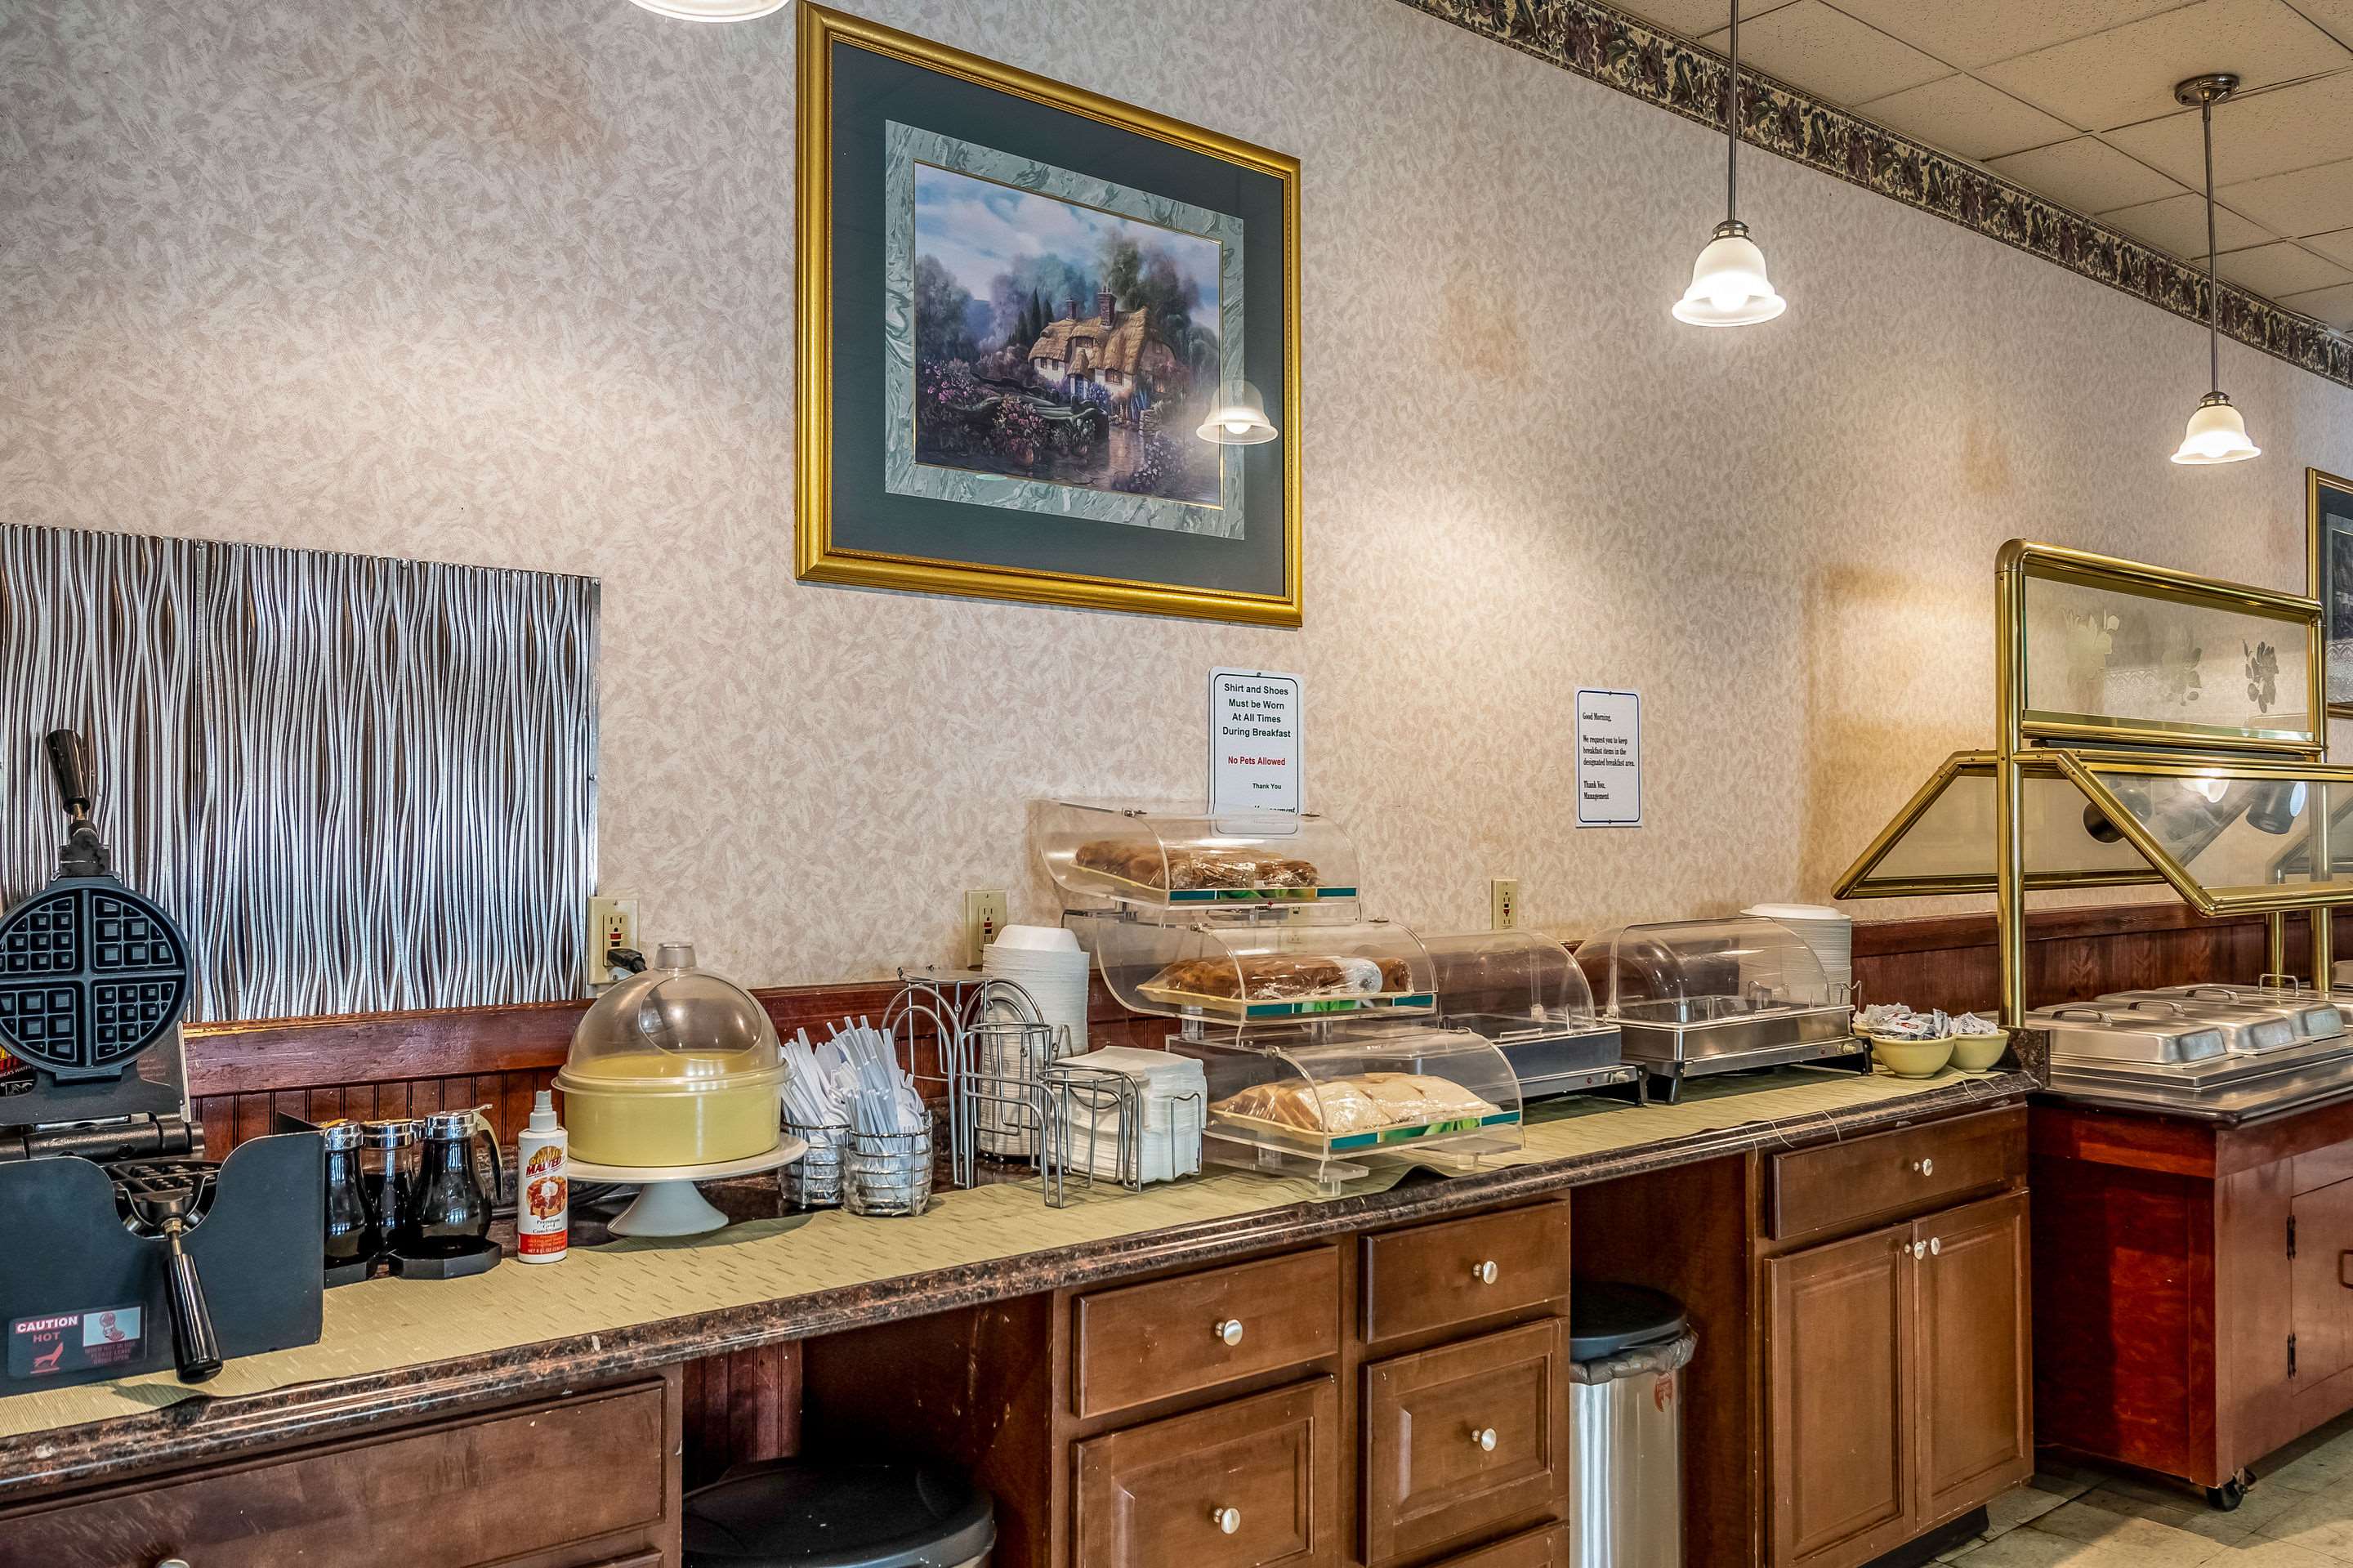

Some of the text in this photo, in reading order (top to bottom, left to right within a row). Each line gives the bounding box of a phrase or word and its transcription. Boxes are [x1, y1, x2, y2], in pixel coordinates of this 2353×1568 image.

[1224, 683, 1243, 692] Shirt
[1263, 686, 1288, 695] Shoes
[1229, 699, 1284, 709] Must be Worn
[1232, 713, 1281, 723] At All Times
[1222, 726, 1291, 737] During Breakfast
[1583, 735, 1589, 743] We
[1590, 736, 1605, 744] request
[1619, 736, 1627, 745] keep
[1583, 746, 1602, 754] breakfast
[1228, 756, 1286, 766] No Pets Allowed
[1583, 758, 1605, 766] designated
[1606, 758, 1624, 766] breakfast
[1583, 780, 1596, 788] Thank
[17, 1316, 78, 1332] CAUTION
[33, 1331, 60, 1342] HOT
